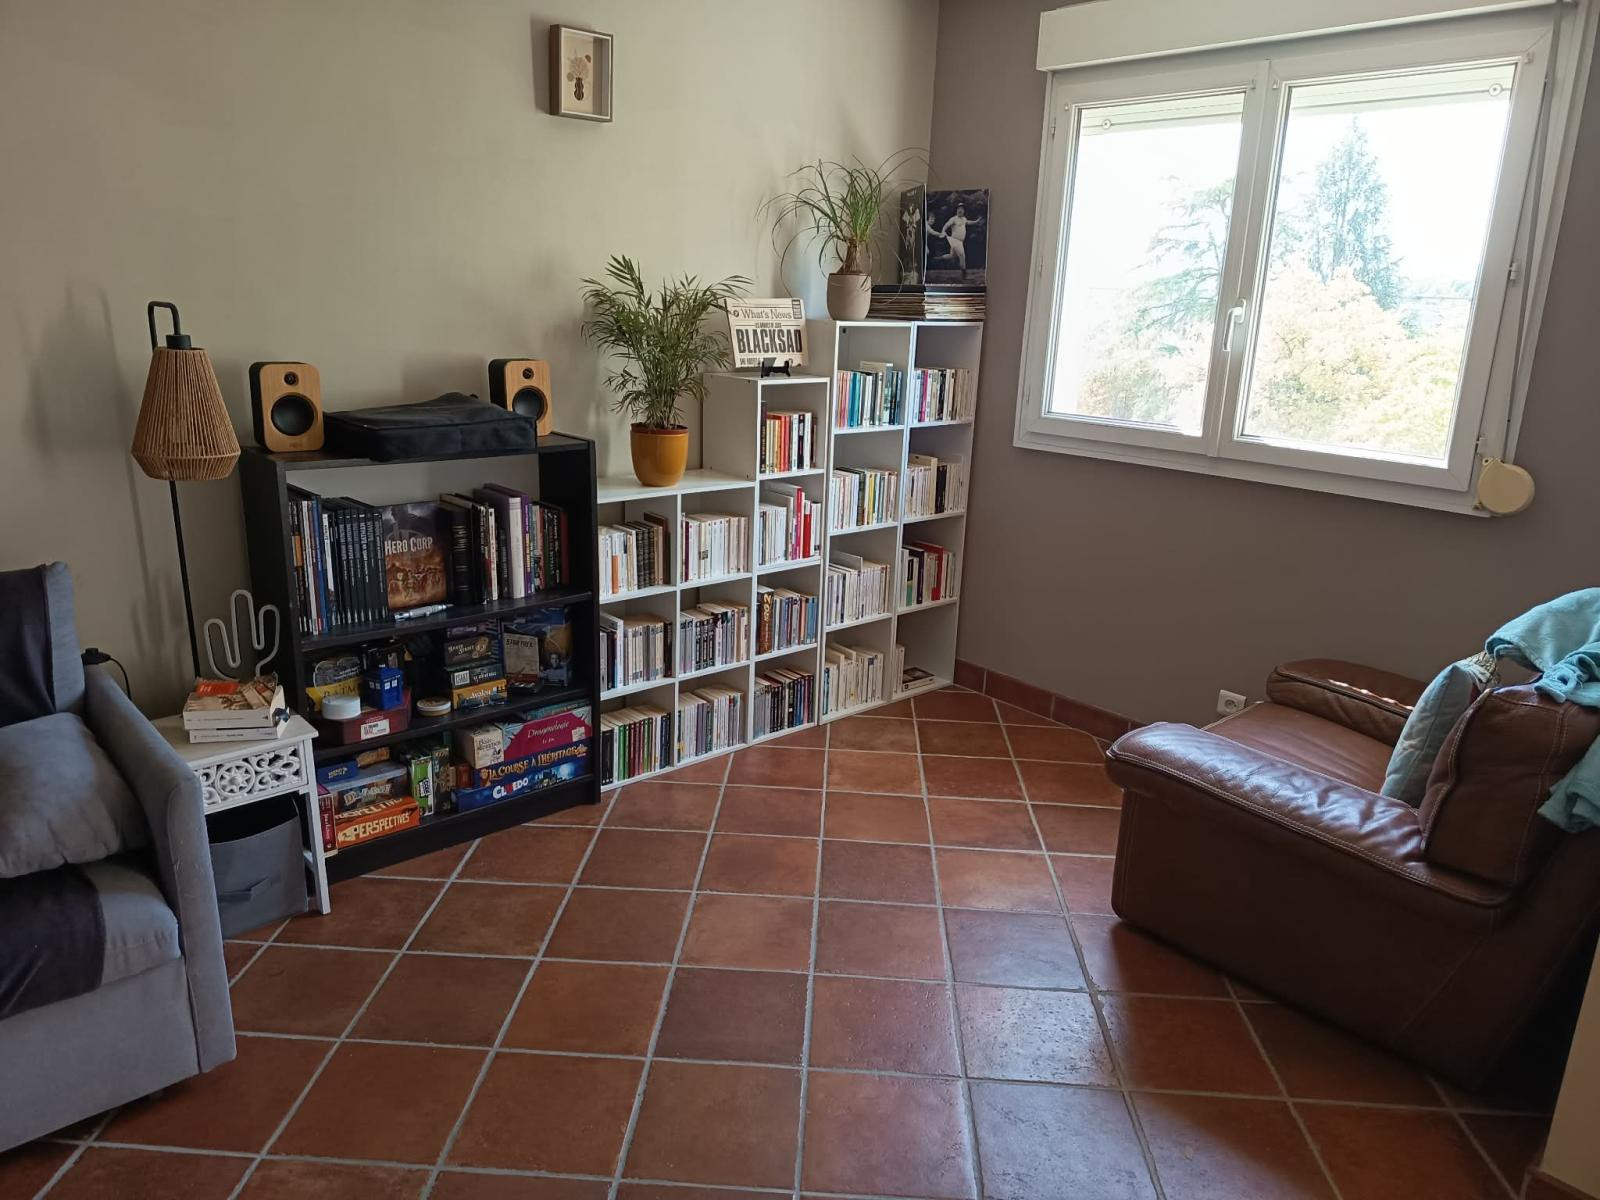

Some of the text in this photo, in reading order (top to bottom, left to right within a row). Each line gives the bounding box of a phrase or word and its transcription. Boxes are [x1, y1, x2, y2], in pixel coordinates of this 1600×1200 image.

[740, 307, 792, 319] What's News
[735, 328, 803, 354] BLACKSAD
[384, 536, 433, 556] HERO CORP
[353, 811, 410, 840] PERSPECTIVES
